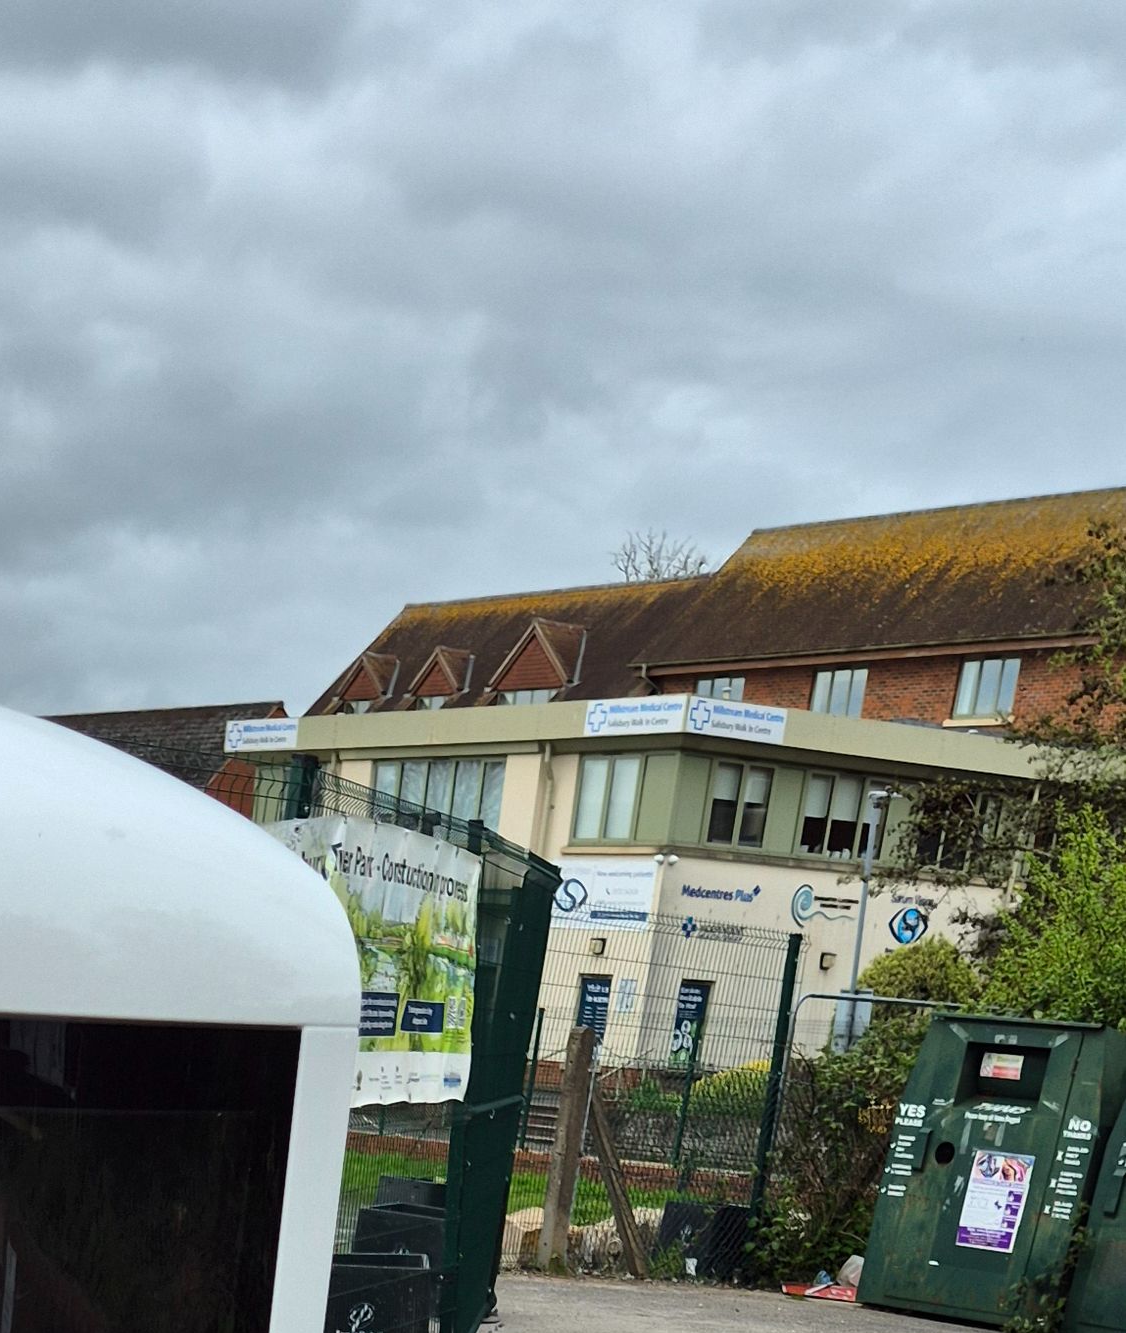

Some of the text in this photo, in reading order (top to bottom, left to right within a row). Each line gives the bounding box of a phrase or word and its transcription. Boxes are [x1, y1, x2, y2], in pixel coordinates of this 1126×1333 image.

[681, 884, 753, 902] Medcentres Plus
[899, 1103, 927, 1118] YES
[1068, 1118, 1091, 1131] NO
